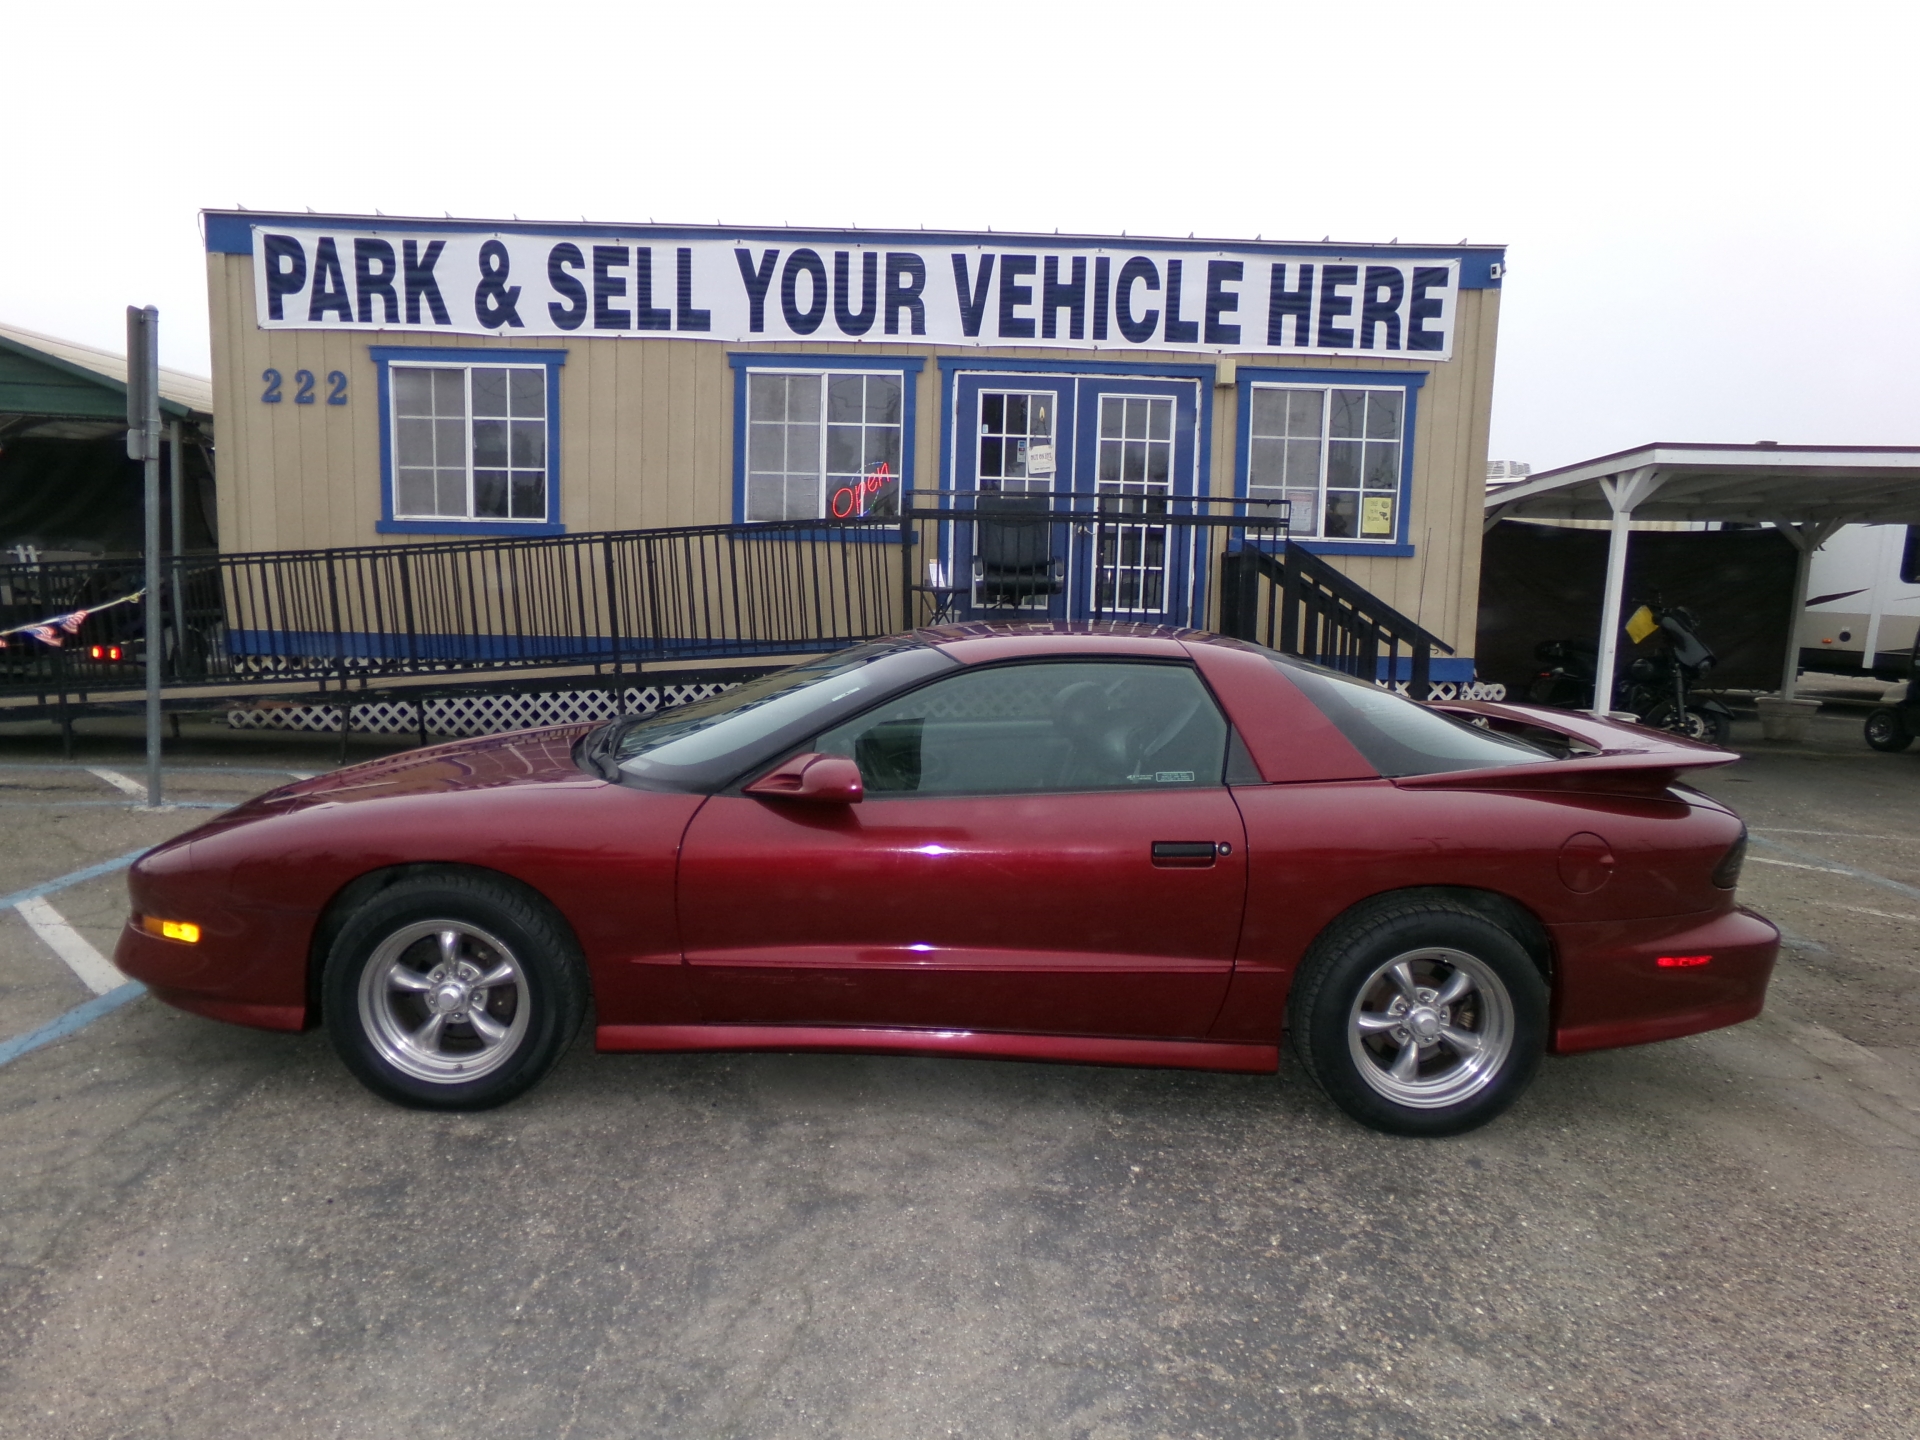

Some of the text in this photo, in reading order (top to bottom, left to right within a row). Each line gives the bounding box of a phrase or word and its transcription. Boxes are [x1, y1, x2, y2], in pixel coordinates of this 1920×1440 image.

[264, 235, 1450, 352] PARK & SELL YOUR VEHICLE HERE
[260, 368, 349, 406] 222
[832, 462, 891, 518] Open
